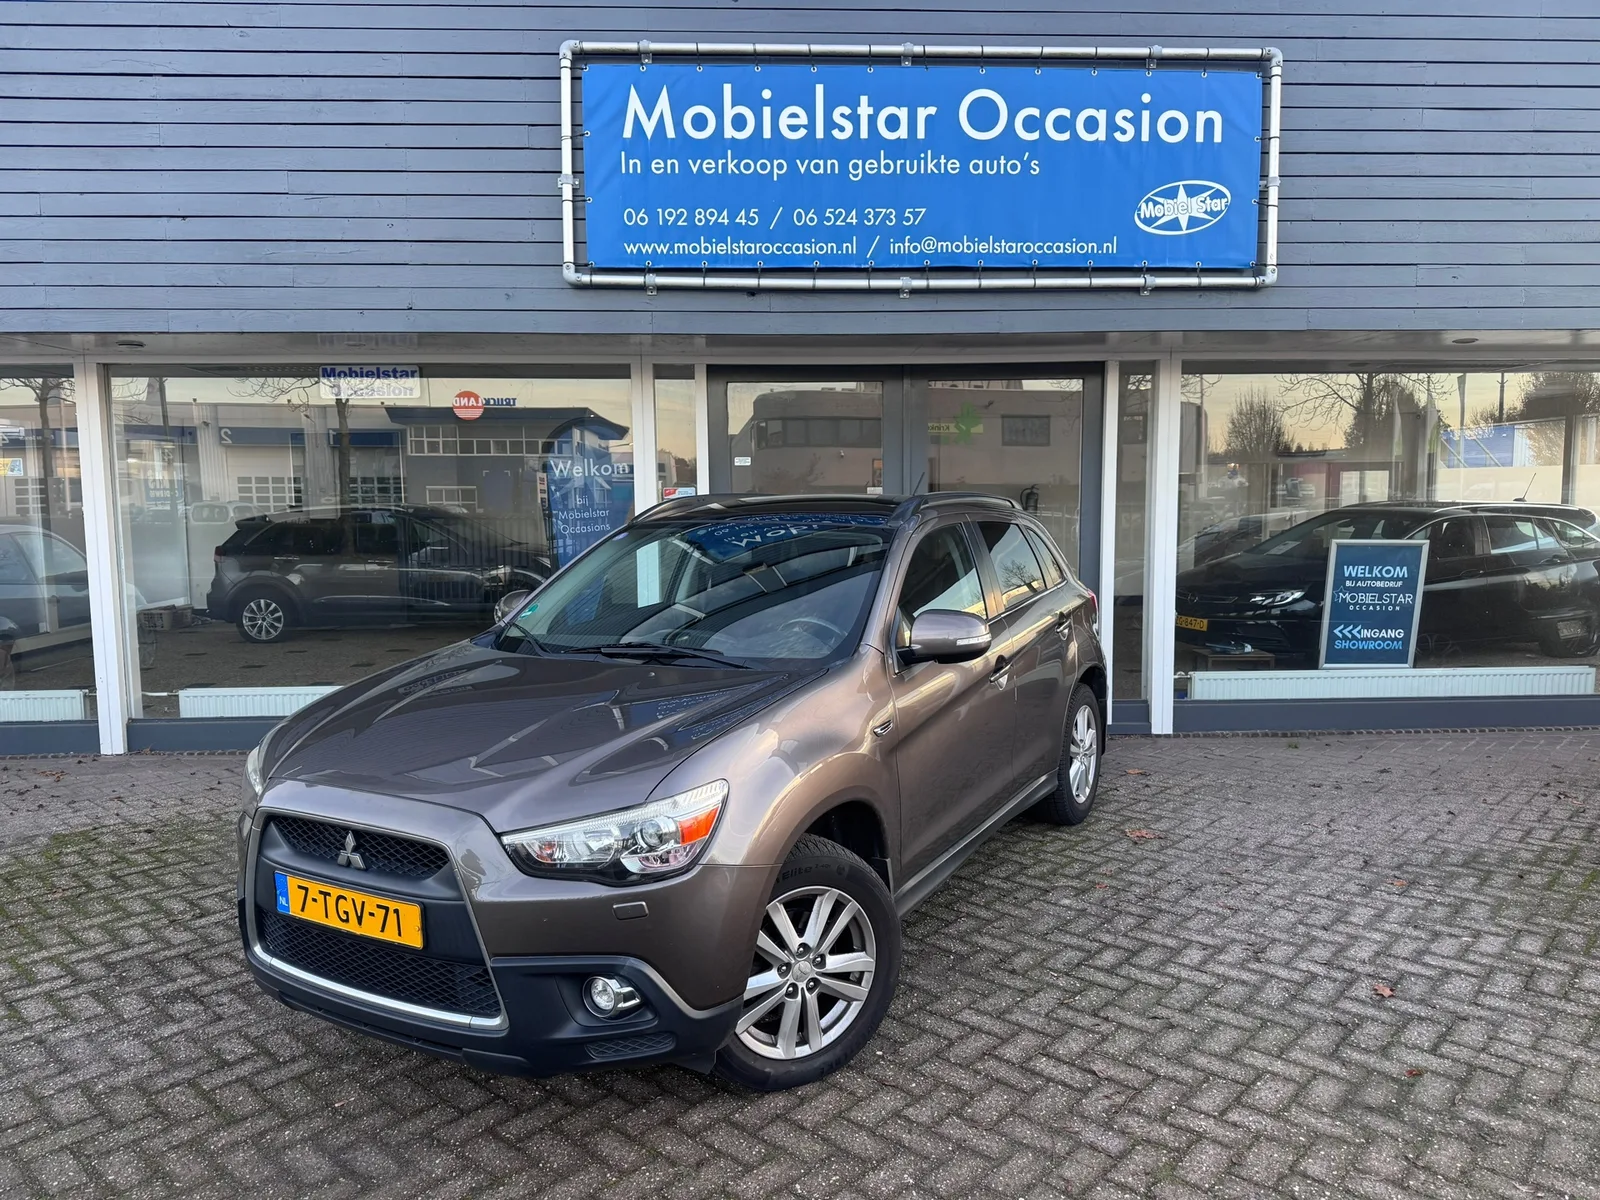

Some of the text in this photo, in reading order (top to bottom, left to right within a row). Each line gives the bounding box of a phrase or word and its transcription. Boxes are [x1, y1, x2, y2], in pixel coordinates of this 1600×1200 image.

[622, 83, 1223, 144] Mobielstar Occasion
[621, 151, 641, 174] In
[651, 158, 679, 175] en
[688, 150, 788, 181] verkoop
[795, 159, 839, 175] van
[848, 150, 960, 181] gebruikte
[1140, 195, 1228, 219] Mobiel Star
[623, 208, 649, 226] 06
[657, 208, 688, 226] 192
[694, 208, 729, 226] 894
[735, 208, 759, 226] 45
[793, 208, 818, 226] 06
[823, 208, 858, 226] 524
[864, 208, 896, 226] 373
[902, 208, 927, 226] 57
[623, 237, 857, 256] www.mobielstaroccasion.nl
[889, 237, 1118, 258] info@mobielstaroccasion.nl
[321, 366, 418, 379] Mobielstar
[549, 458, 630, 478] Welkom
[576, 495, 589, 507] bij
[558, 508, 610, 520] Mobielstar
[560, 523, 611, 535] Occasions
[1343, 565, 1408, 578] WELKOM
[1356, 580, 1404, 588] AUTOBEDRIJF
[1338, 592, 1414, 604] MOBIELSTAR
[1360, 629, 1405, 639] INGANG
[1333, 640, 1403, 650] SHOWROOM
[782, 865, 813, 881] Elite
[279, 885, 402, 938] NL 7-TGV-71
